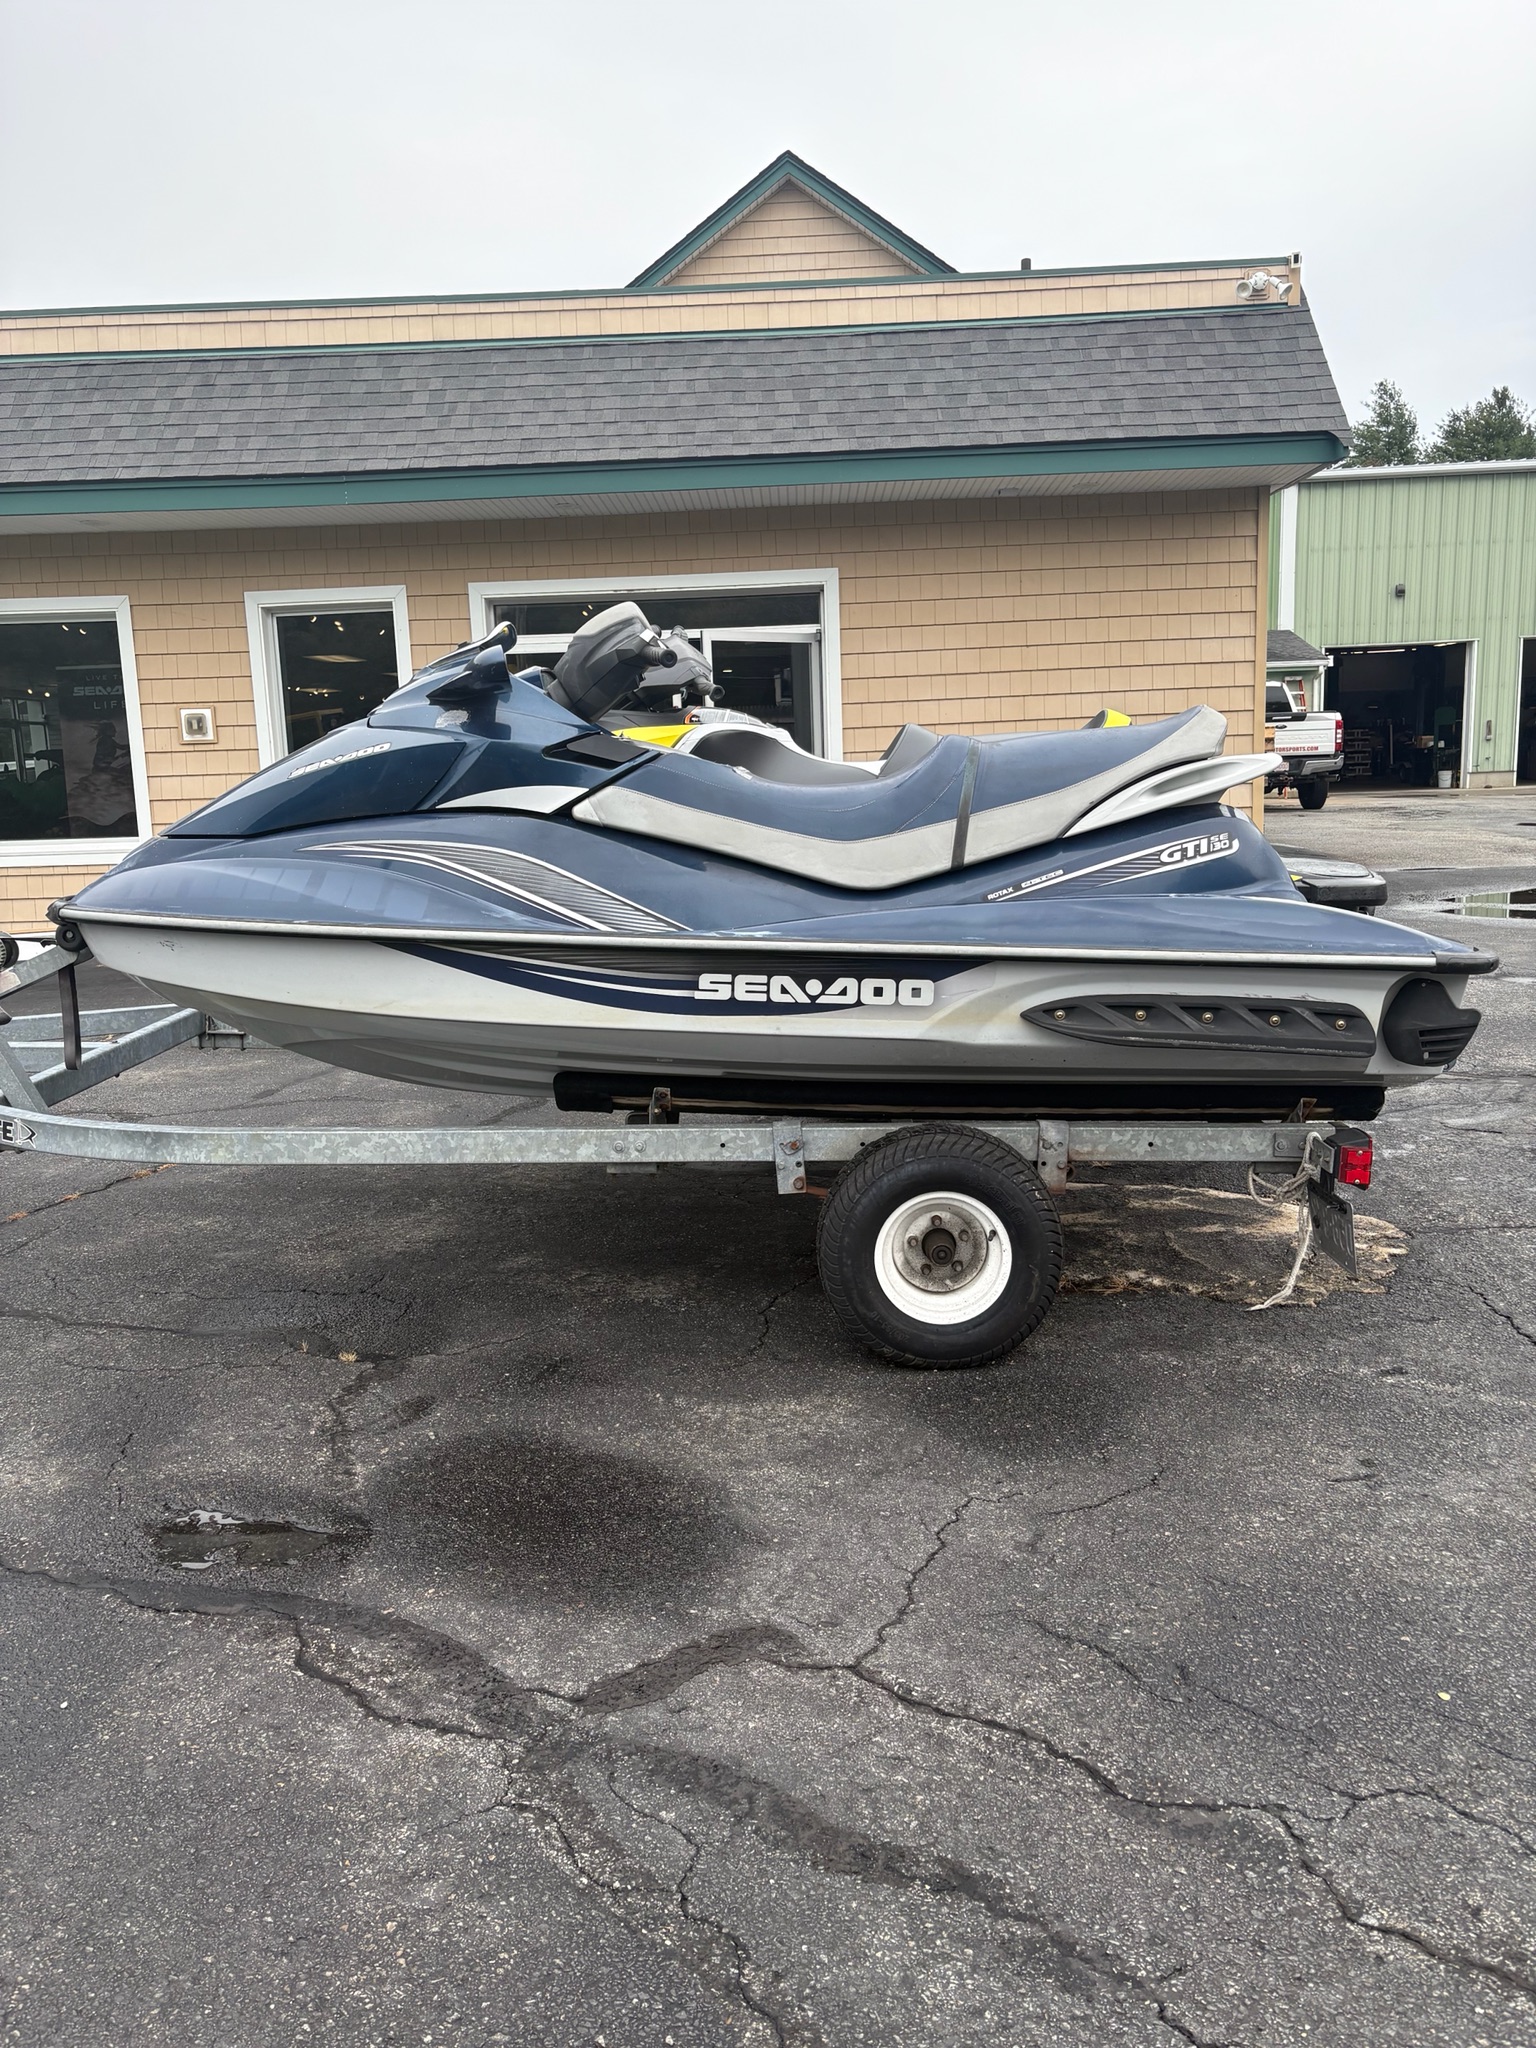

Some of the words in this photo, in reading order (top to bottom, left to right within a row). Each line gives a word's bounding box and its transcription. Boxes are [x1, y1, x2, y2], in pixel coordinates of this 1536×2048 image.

[85, 673, 107, 681] LIVE
[1210, 832, 1229, 842] SE
[1160, 838, 1208, 863] GTI
[1210, 840, 1229, 852] 130
[987, 886, 1014, 900] ROTAX
